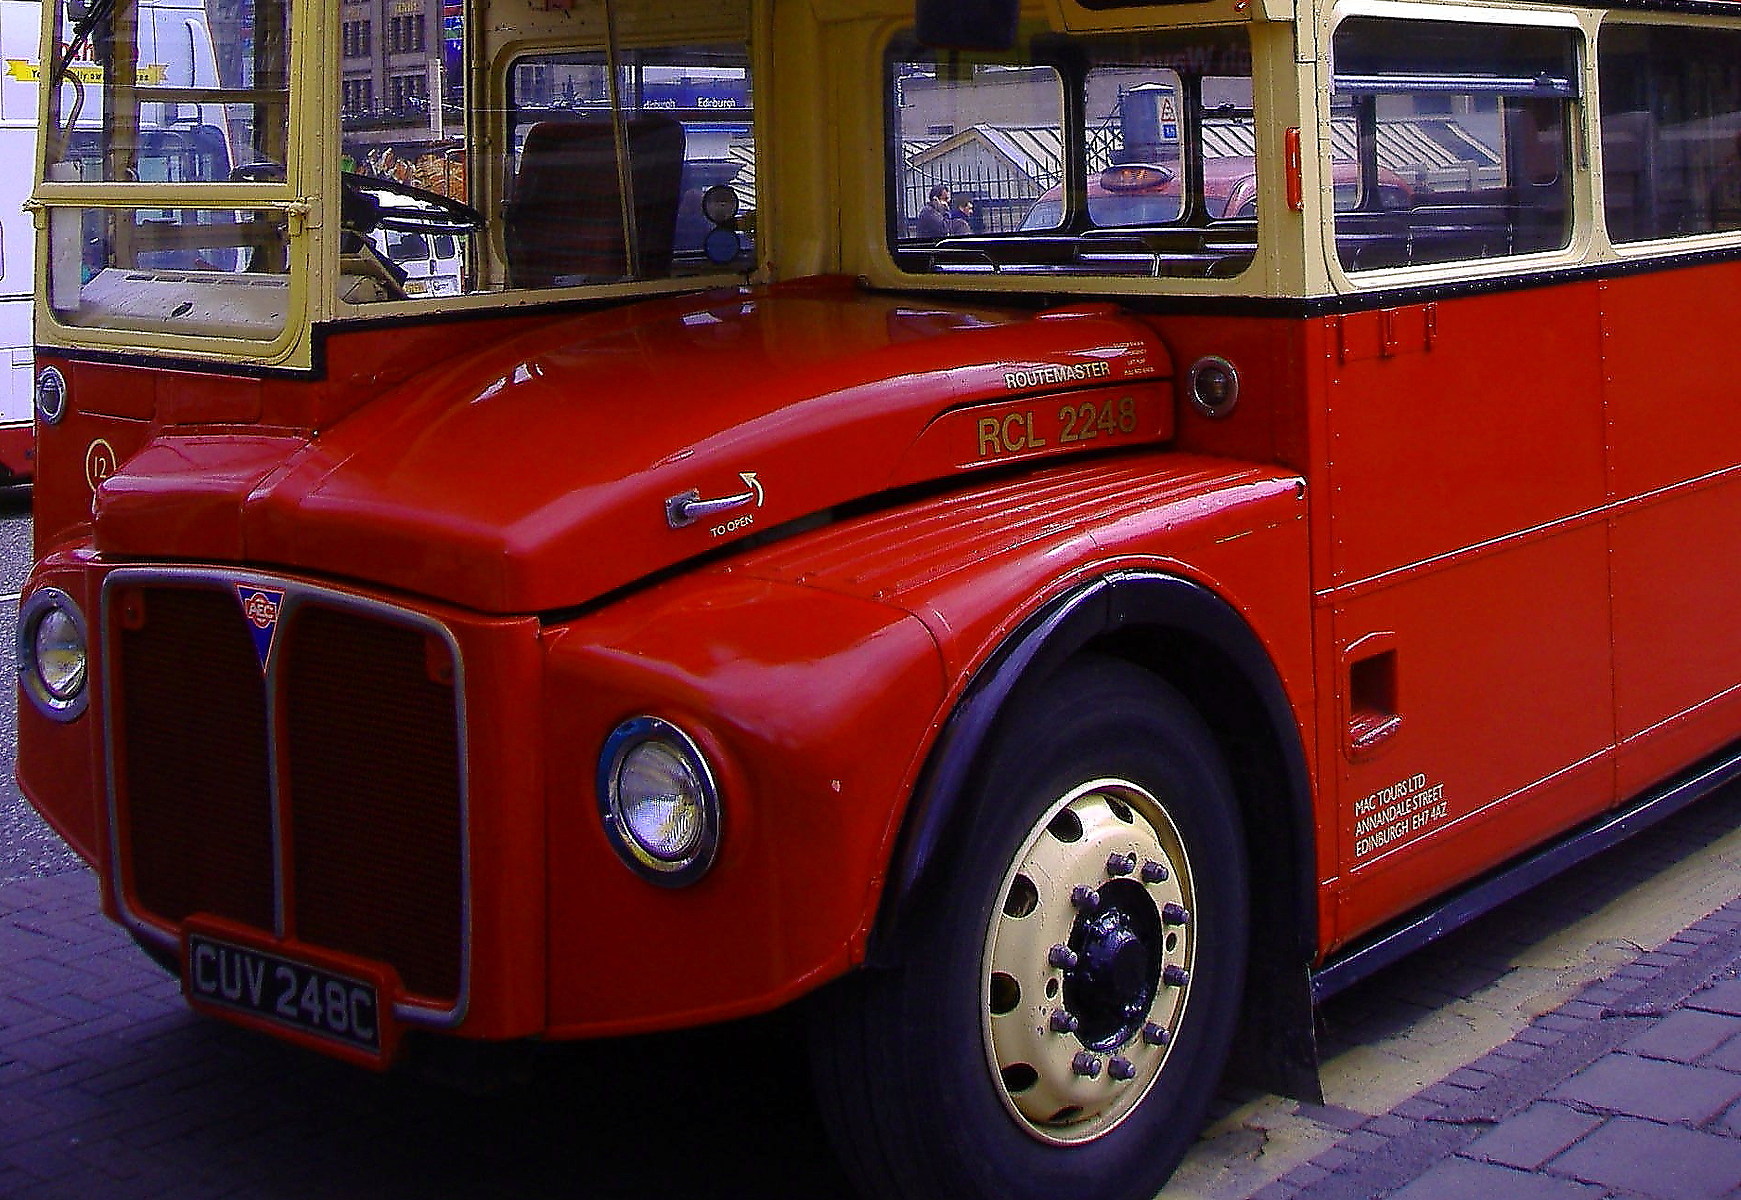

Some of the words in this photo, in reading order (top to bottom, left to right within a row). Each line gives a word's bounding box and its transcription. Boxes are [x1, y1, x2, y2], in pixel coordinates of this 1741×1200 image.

[1003, 361, 1111, 390] ROUTEMASTER
[976, 409, 1047, 456] RCL
[1057, 397, 1138, 444] 2248
[94, 456, 107, 478] 12
[710, 524, 726, 538] TO
[726, 514, 754, 532] OPEN
[1355, 794, 1376, 817] MAC
[1377, 780, 1408, 807] TOURS
[1407, 773, 1426, 793] LTD
[1355, 798, 1412, 837] ANNANDALE
[1412, 784, 1445, 810] STREET
[1355, 818, 1409, 857] EDINBURGH
[195, 943, 266, 1007] CUV
[274, 966, 374, 1040] 248C
